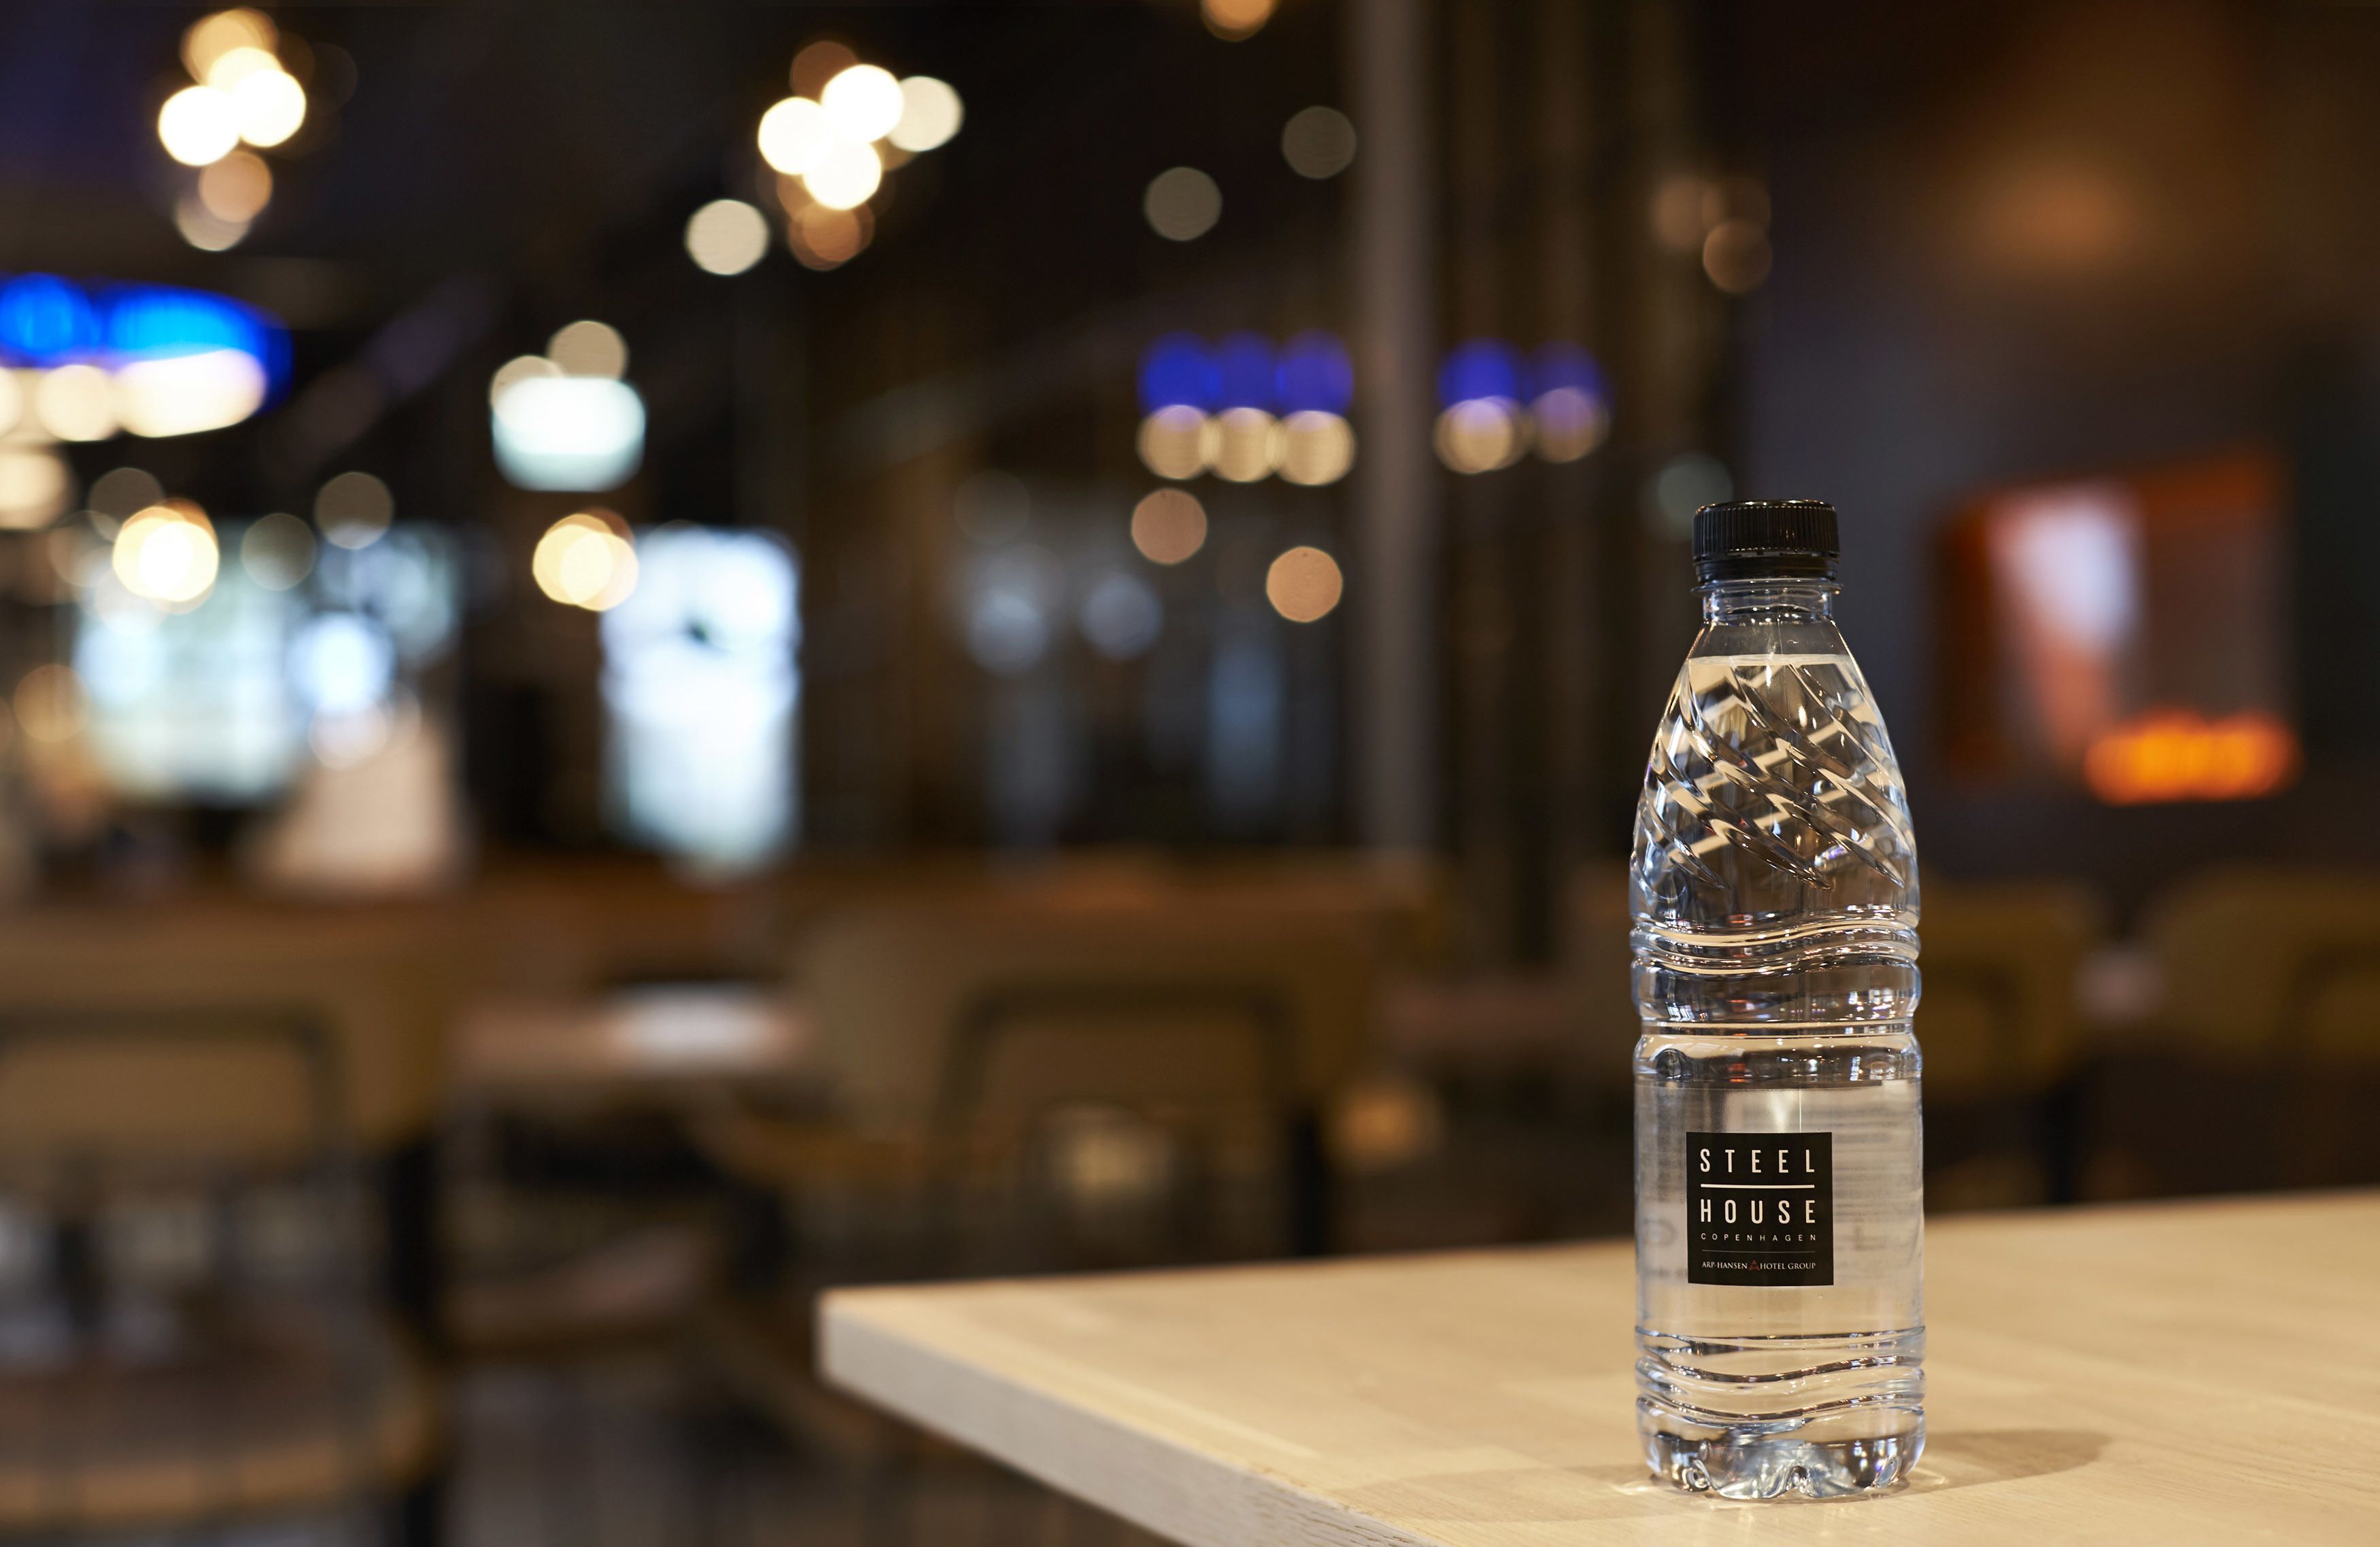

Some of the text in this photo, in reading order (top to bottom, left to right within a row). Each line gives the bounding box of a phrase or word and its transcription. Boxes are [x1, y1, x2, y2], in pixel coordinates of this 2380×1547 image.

[1700, 1148, 1815, 1173] STEEL
[1700, 1199, 1816, 1224] HOUSE
[1701, 1233, 1816, 1242] COPENHAGEN
[1701, 1261, 1816, 1270] ARP-HANSEN HOTEL GROUP
